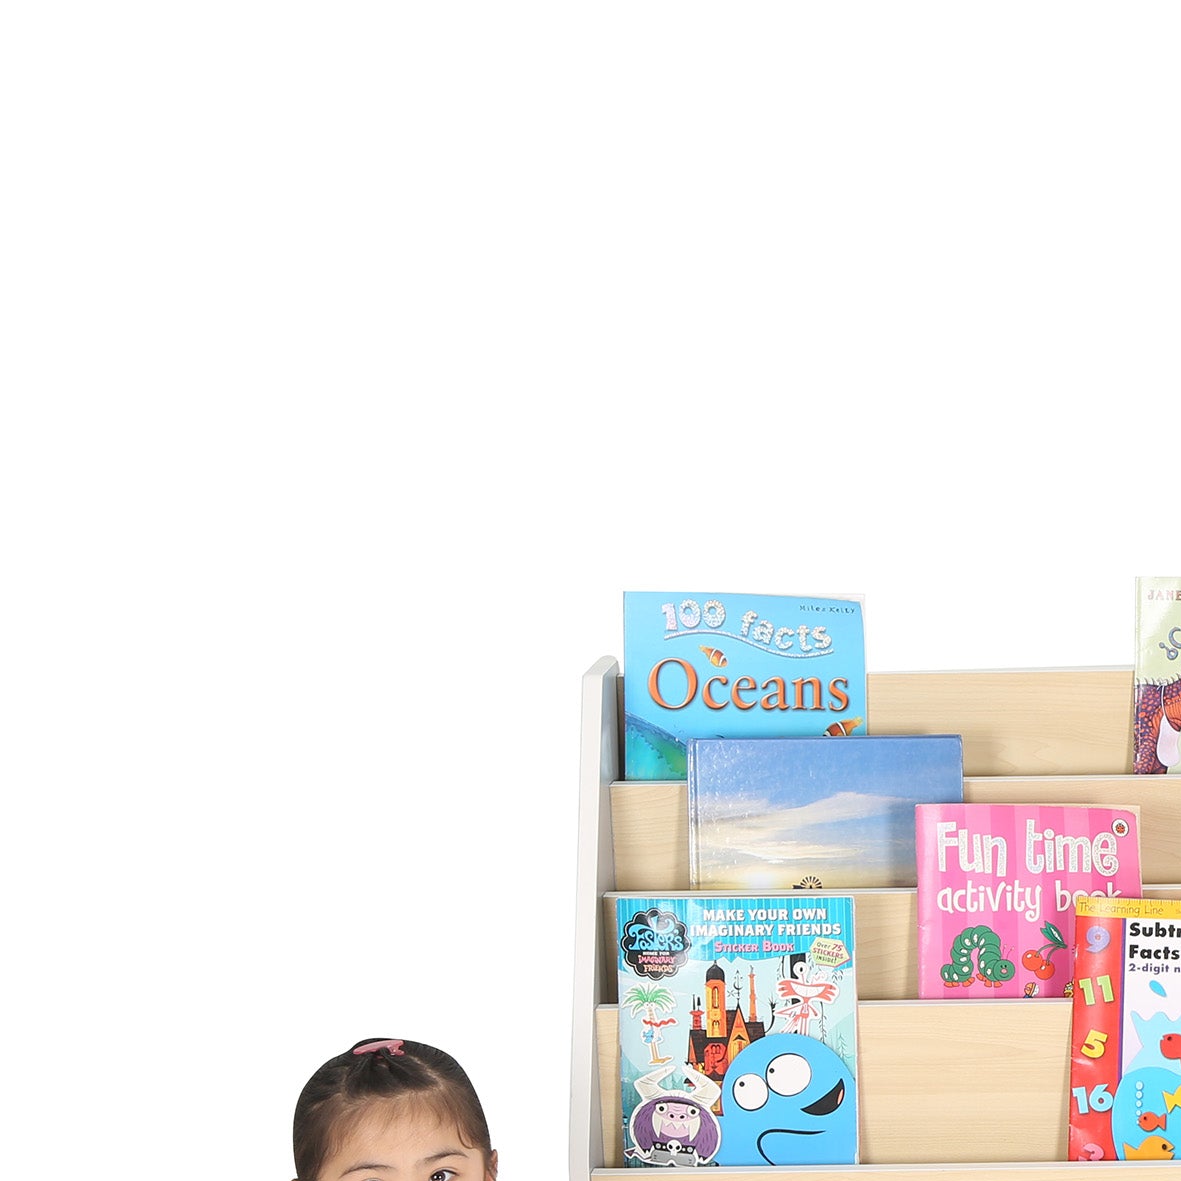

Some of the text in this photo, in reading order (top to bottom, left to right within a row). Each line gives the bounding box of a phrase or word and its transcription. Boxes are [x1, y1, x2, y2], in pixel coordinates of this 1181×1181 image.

[661, 599, 832, 651] 100 facts
[648, 658, 850, 712] Oceans
[936, 819, 1119, 877] Fun time
[703, 908, 827, 921] MAKE YOUR OWN
[936, 880, 1042, 922] activity
[1079, 902, 1164, 917] The Learning Line
[690, 923, 841, 937] IMAGINARY FRIENDS
[1085, 925, 1111, 953] 9
[812, 947, 844, 960] STICKERS
[832, 943, 844, 952] 75
[1128, 945, 1181, 961] Facts
[1128, 963, 1170, 975] 2-digit
[1078, 974, 1115, 1006] 11
[1080, 1029, 1108, 1059] 5
[1072, 1083, 1114, 1115] 16
